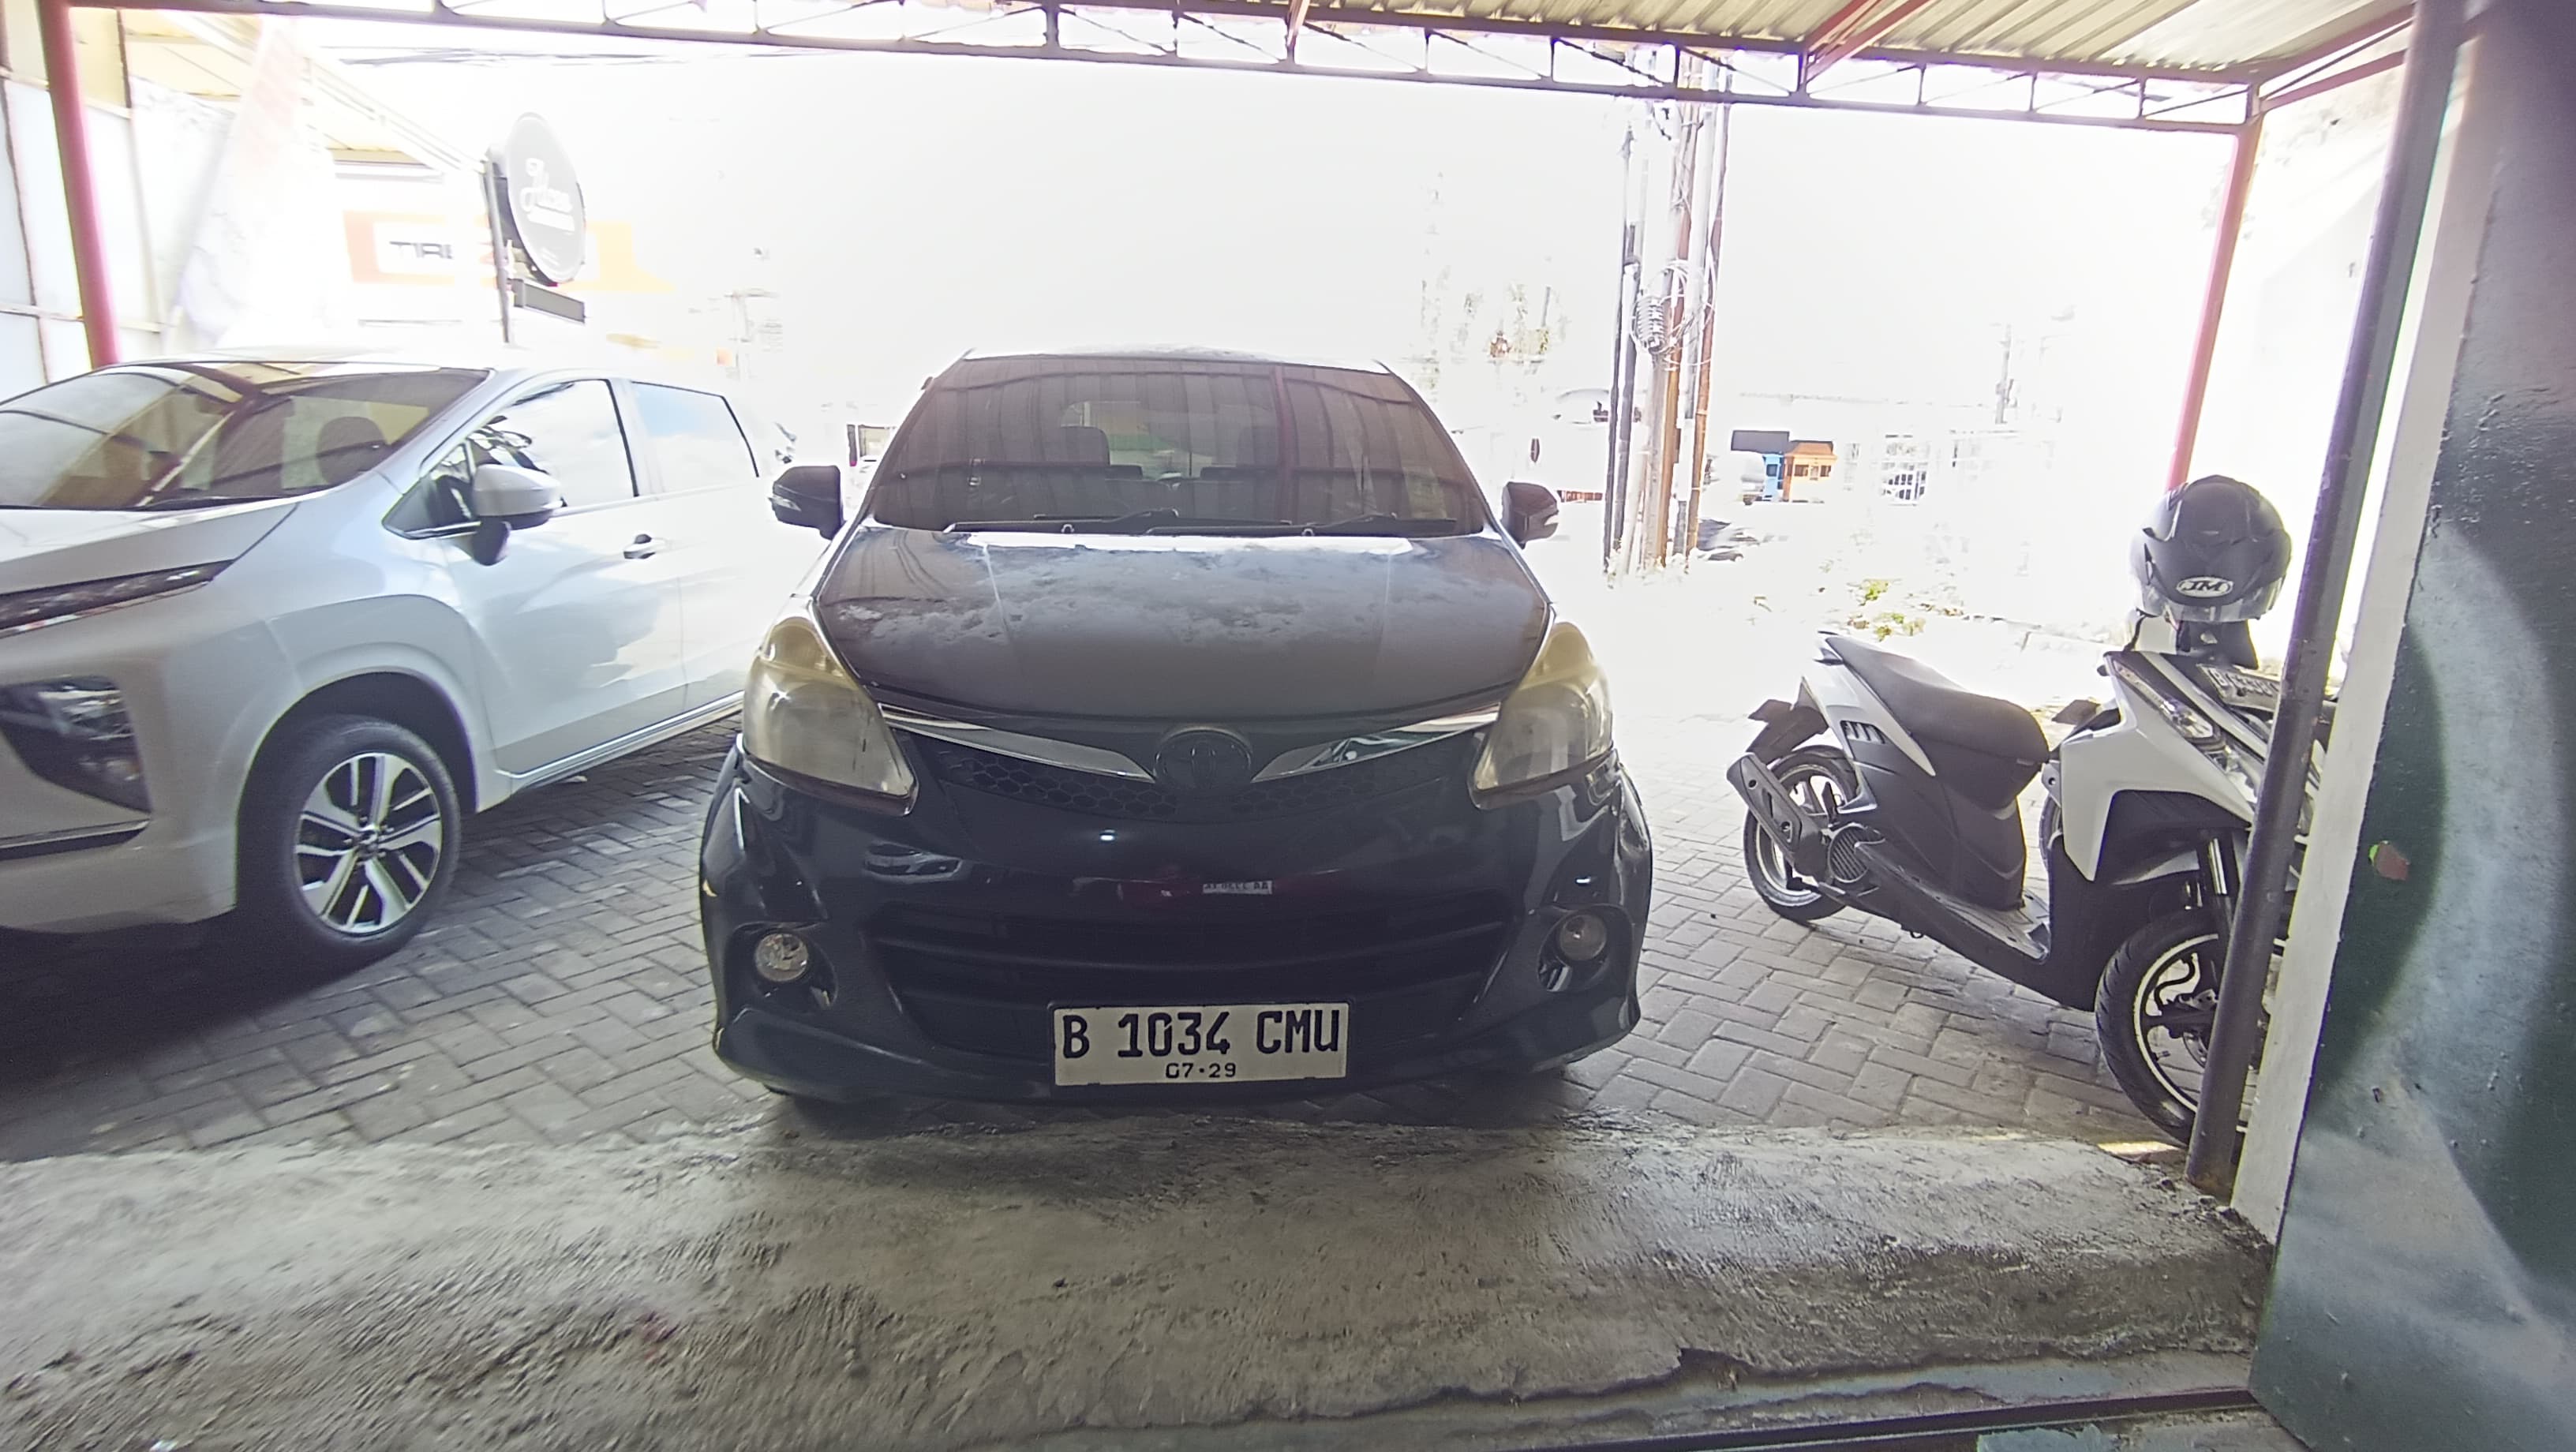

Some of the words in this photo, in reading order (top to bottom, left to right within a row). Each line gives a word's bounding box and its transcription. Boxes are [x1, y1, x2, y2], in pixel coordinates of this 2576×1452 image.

[1063, 1015, 1090, 1058] B
[1118, 1012, 1230, 1057] 1034
[1256, 1009, 1340, 1054] CMU
